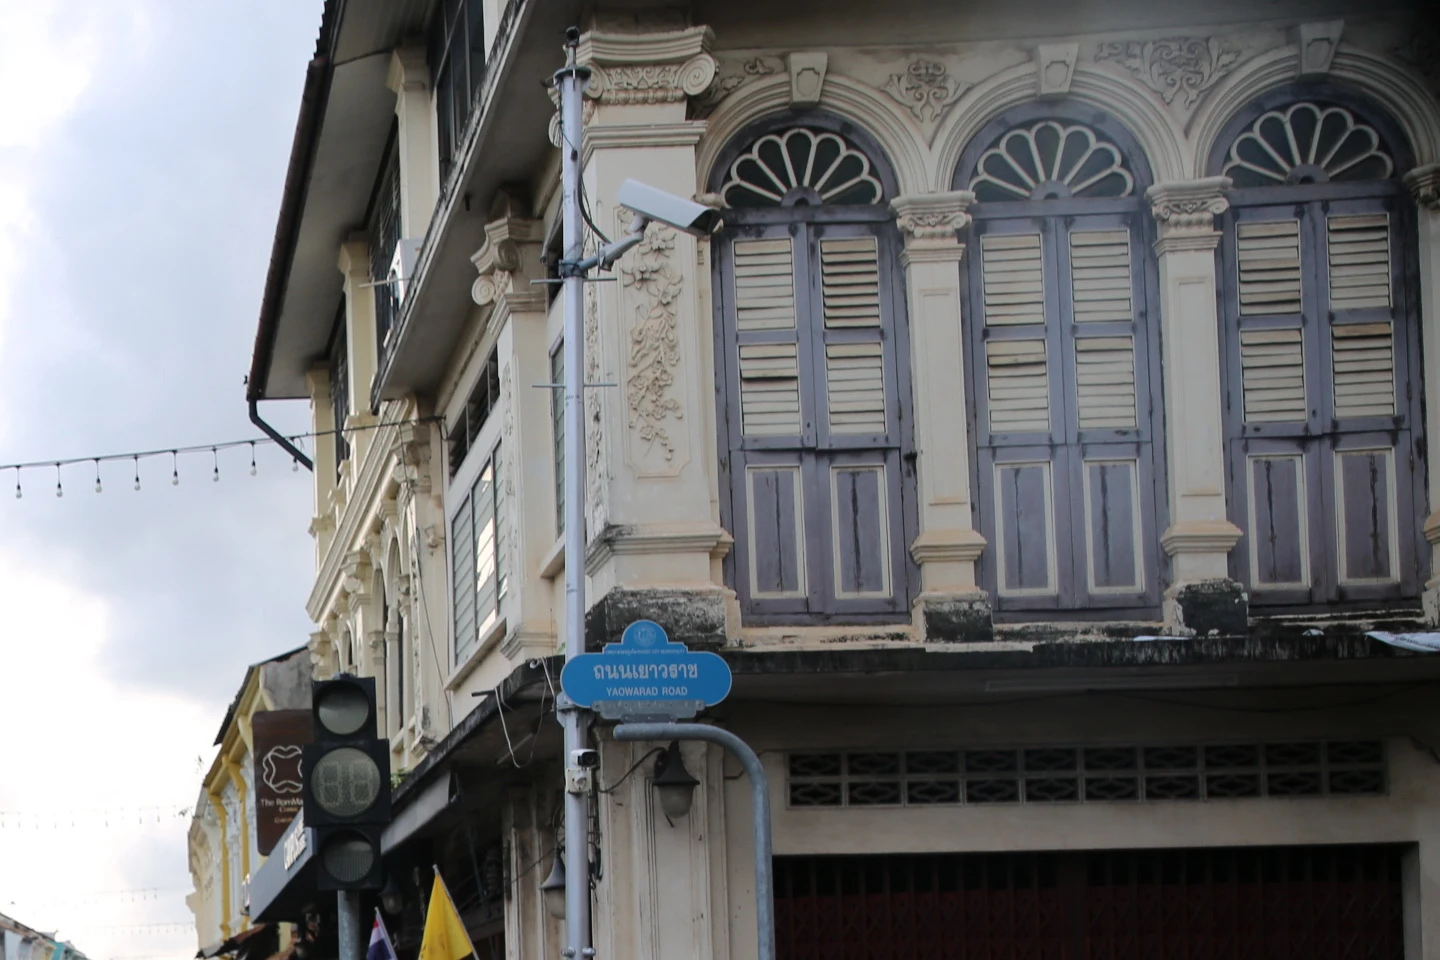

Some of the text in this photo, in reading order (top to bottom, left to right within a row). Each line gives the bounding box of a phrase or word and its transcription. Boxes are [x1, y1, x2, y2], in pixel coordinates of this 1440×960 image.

[593, 663, 698, 680] ถนนเยาวราช
[606, 686, 688, 697] YAOWARAD ROAD
[260, 798, 275, 807] The
